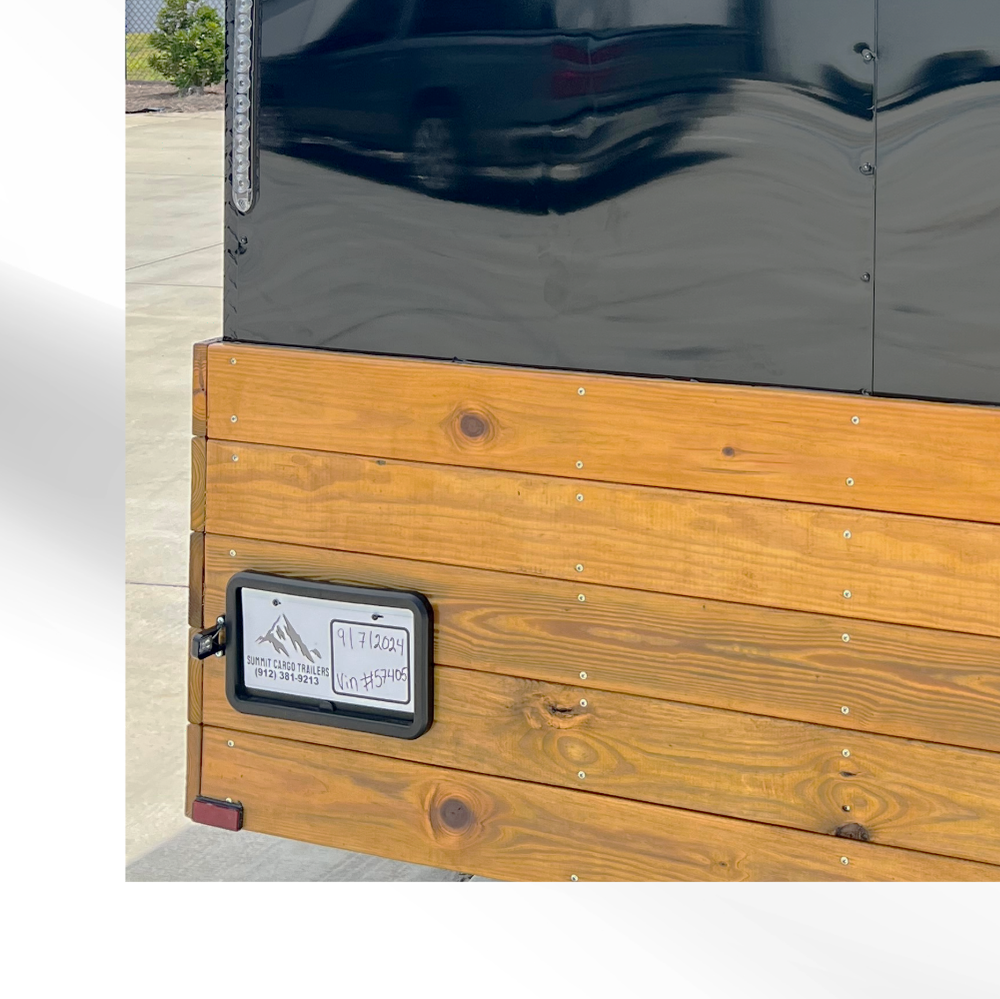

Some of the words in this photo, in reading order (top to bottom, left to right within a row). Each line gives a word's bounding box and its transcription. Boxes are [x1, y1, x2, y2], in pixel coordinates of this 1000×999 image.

[246, 655, 272, 669] SUMMIT
[273, 659, 296, 672] CARGO
[297, 663, 330, 677] TRAILERS
[254, 668, 277, 681] (912)
[279, 671, 320, 686] 381-9213
